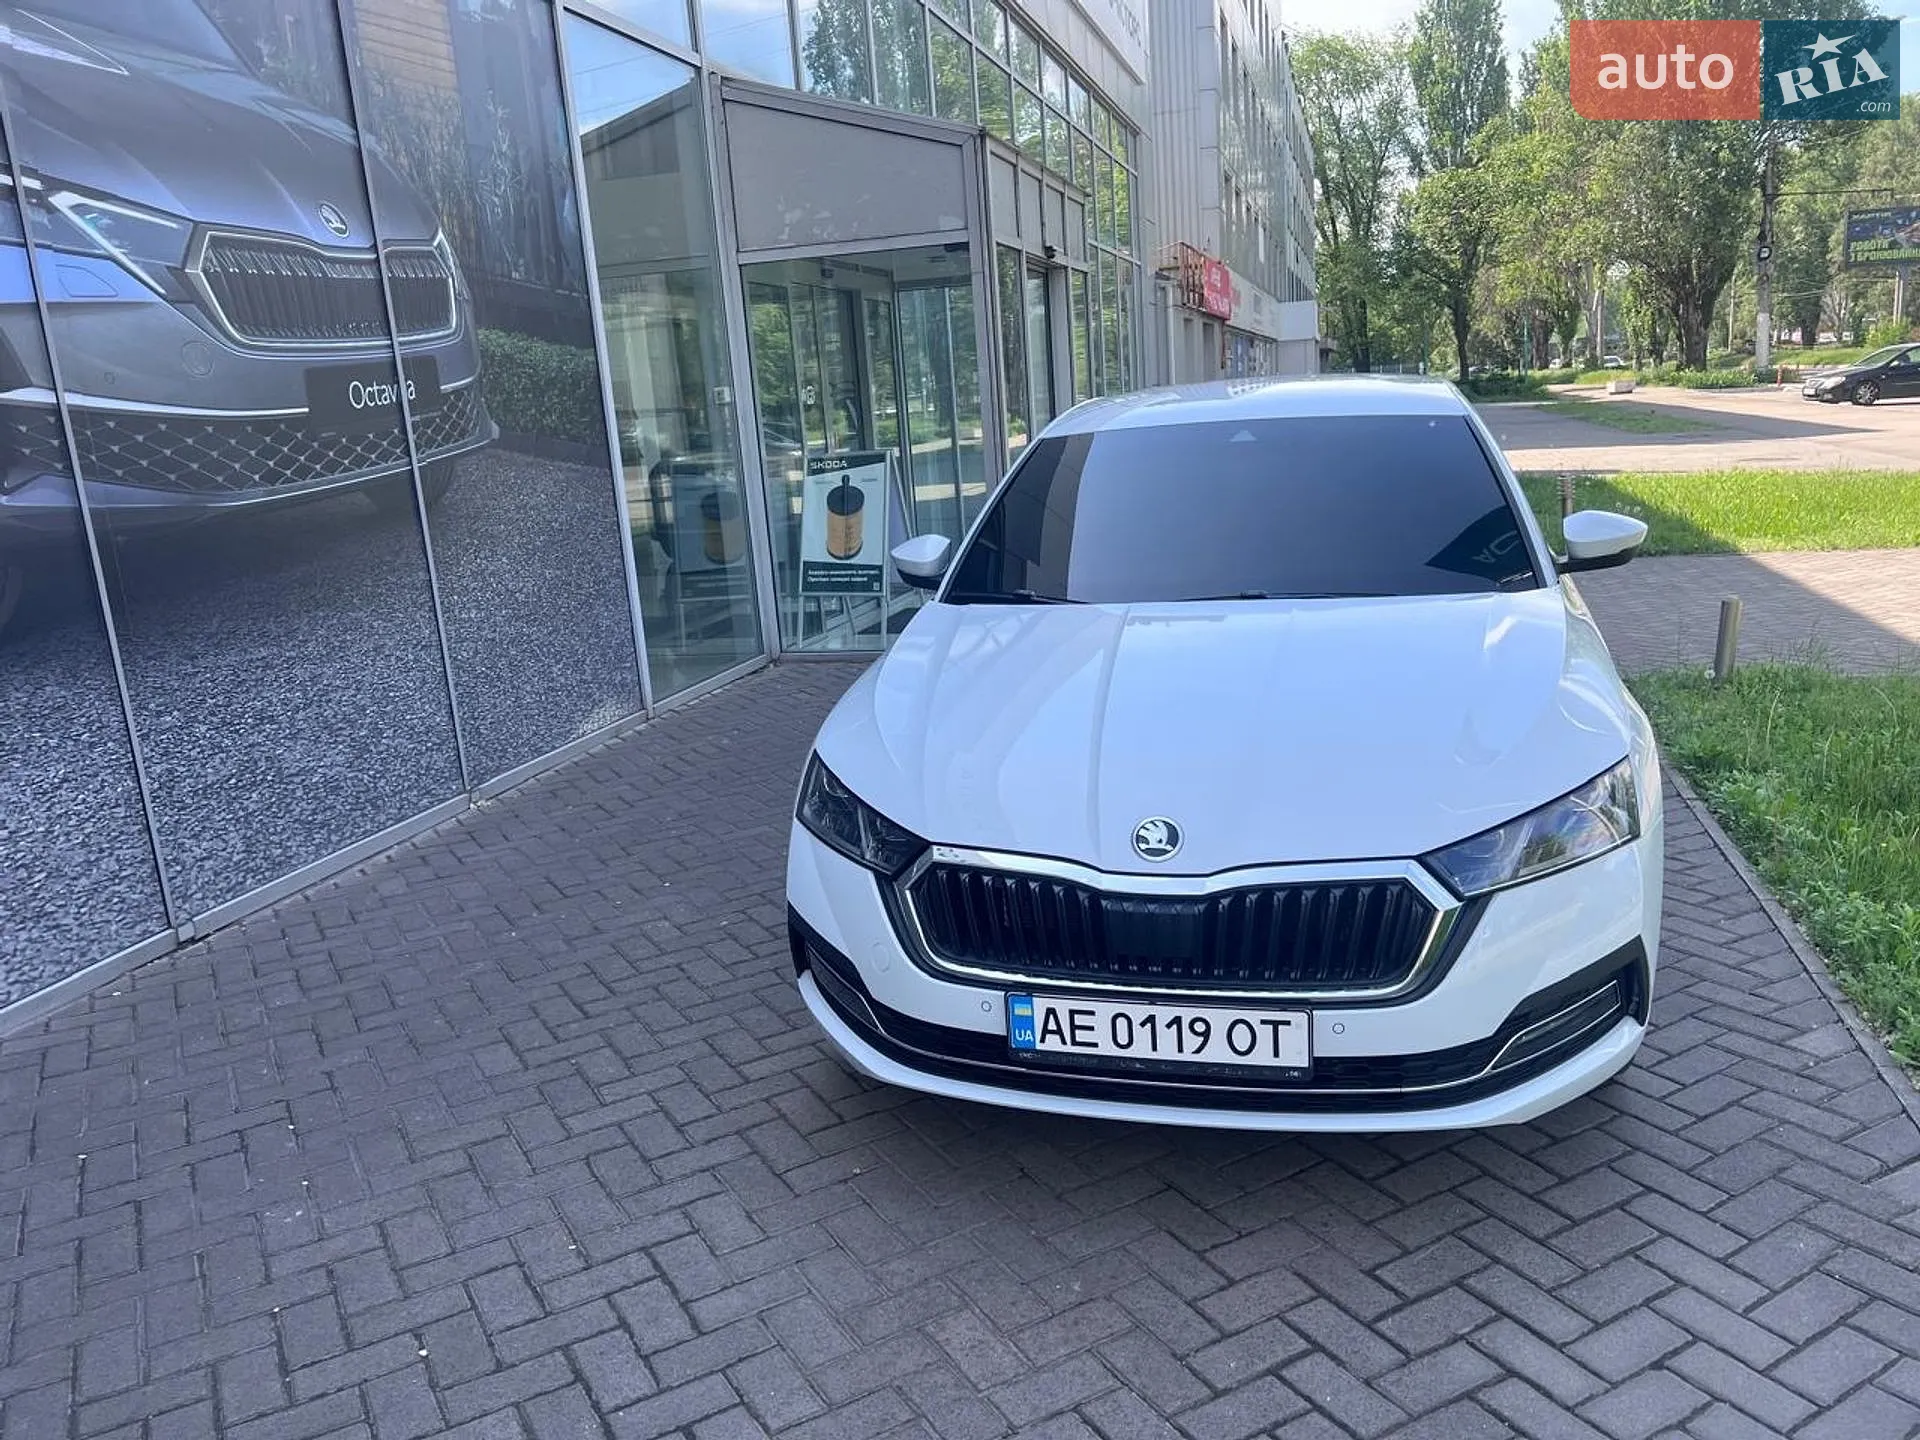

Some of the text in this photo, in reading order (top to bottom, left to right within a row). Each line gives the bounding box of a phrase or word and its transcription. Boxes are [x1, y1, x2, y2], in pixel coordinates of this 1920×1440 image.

[349, 380, 416, 409] Octava
[1015, 1029, 1035, 1042] UA
[1039, 1007, 1292, 1059] AE 0119 OT
